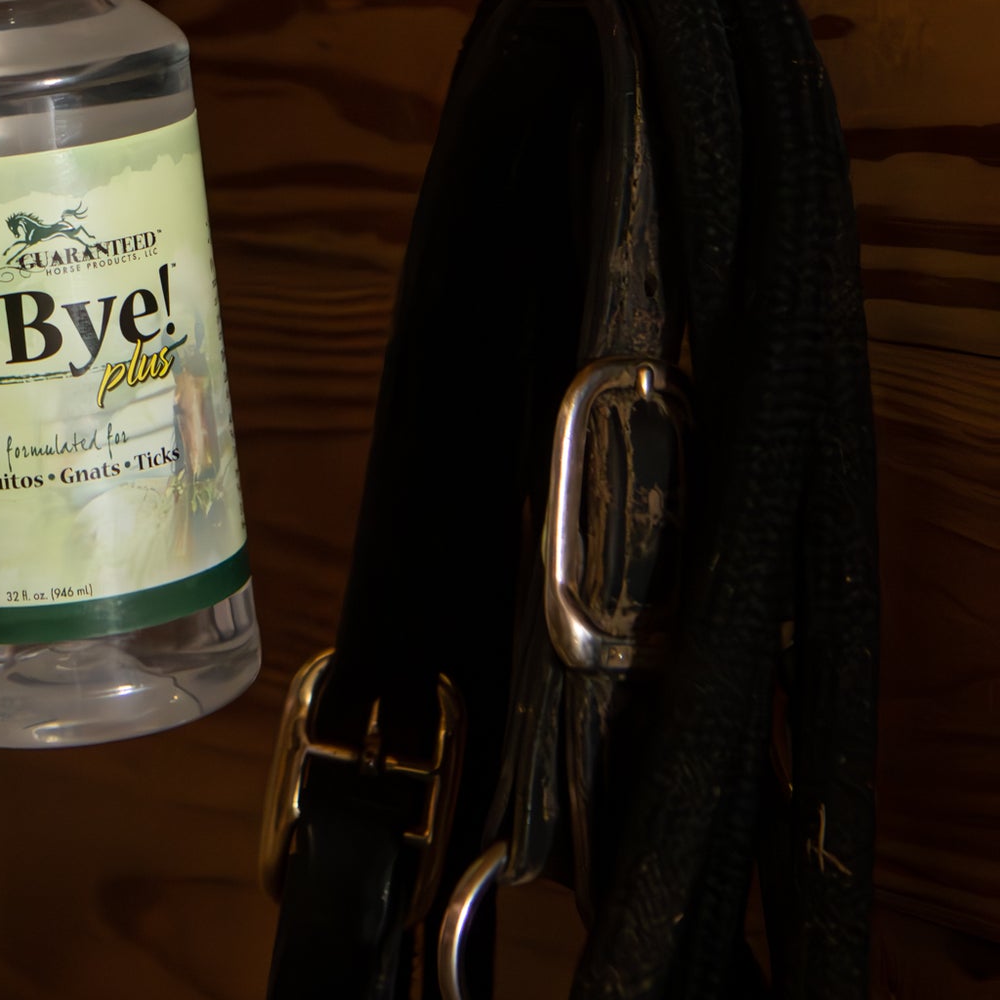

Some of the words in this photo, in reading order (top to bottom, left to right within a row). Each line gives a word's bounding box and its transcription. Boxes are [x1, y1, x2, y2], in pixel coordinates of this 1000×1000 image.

[46, 265, 81, 277] HORSE
[87, 254, 141, 270] PRODUCTS,
[144, 247, 158, 258] LLC
[97, 339, 176, 408] plus
[6, 430, 99, 471] formulated
[107, 422, 129, 459] for
[60, 461, 121, 485] Gnats
[134, 446, 180, 471] Ticks
[6, 591, 20, 602] 32
[22, 590, 31, 601] fl.
[33, 592, 48, 601] oz.
[51, 585, 75, 601] (946
[77, 584, 93, 597] ml)
